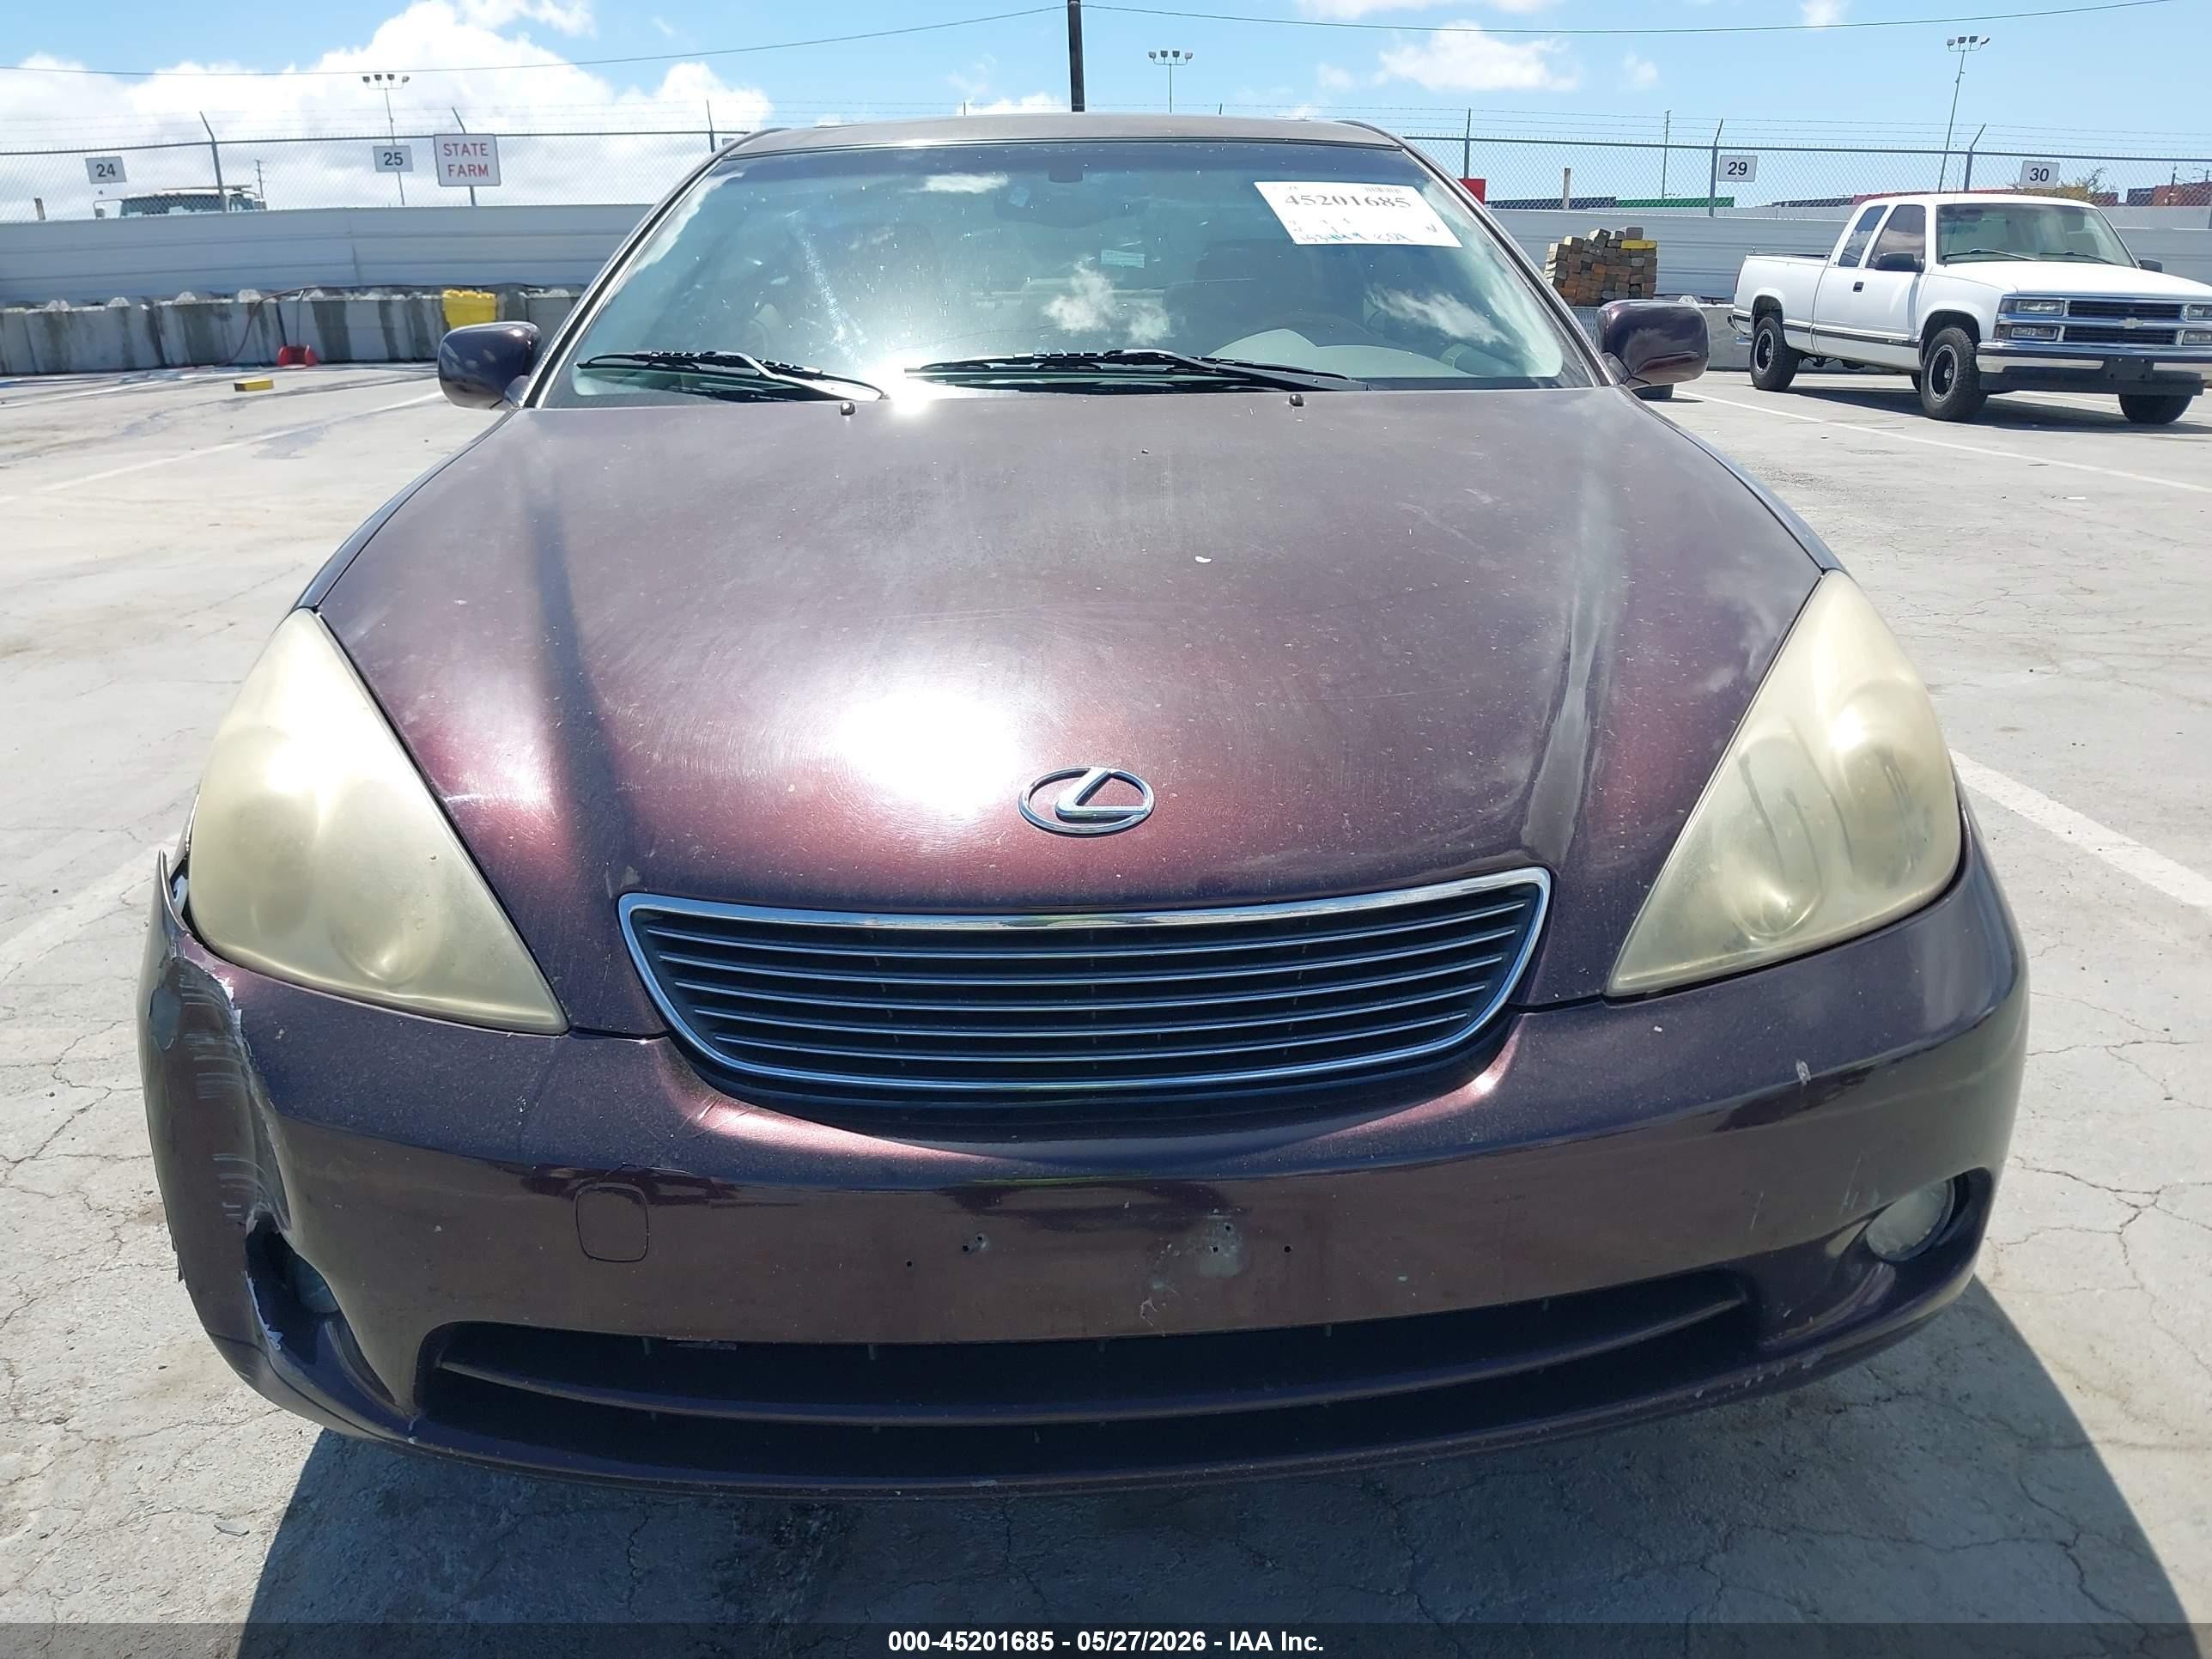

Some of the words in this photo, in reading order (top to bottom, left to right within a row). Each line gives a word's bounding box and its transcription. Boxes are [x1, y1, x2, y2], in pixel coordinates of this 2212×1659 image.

[443, 143, 489, 157] STATE
[383, 151, 404, 167] 25
[96, 163, 116, 177] 24
[447, 164, 489, 178] FARM
[1727, 161, 1748, 176] 29
[2029, 167, 2050, 182] 30
[1285, 194, 1412, 209] 45201685
